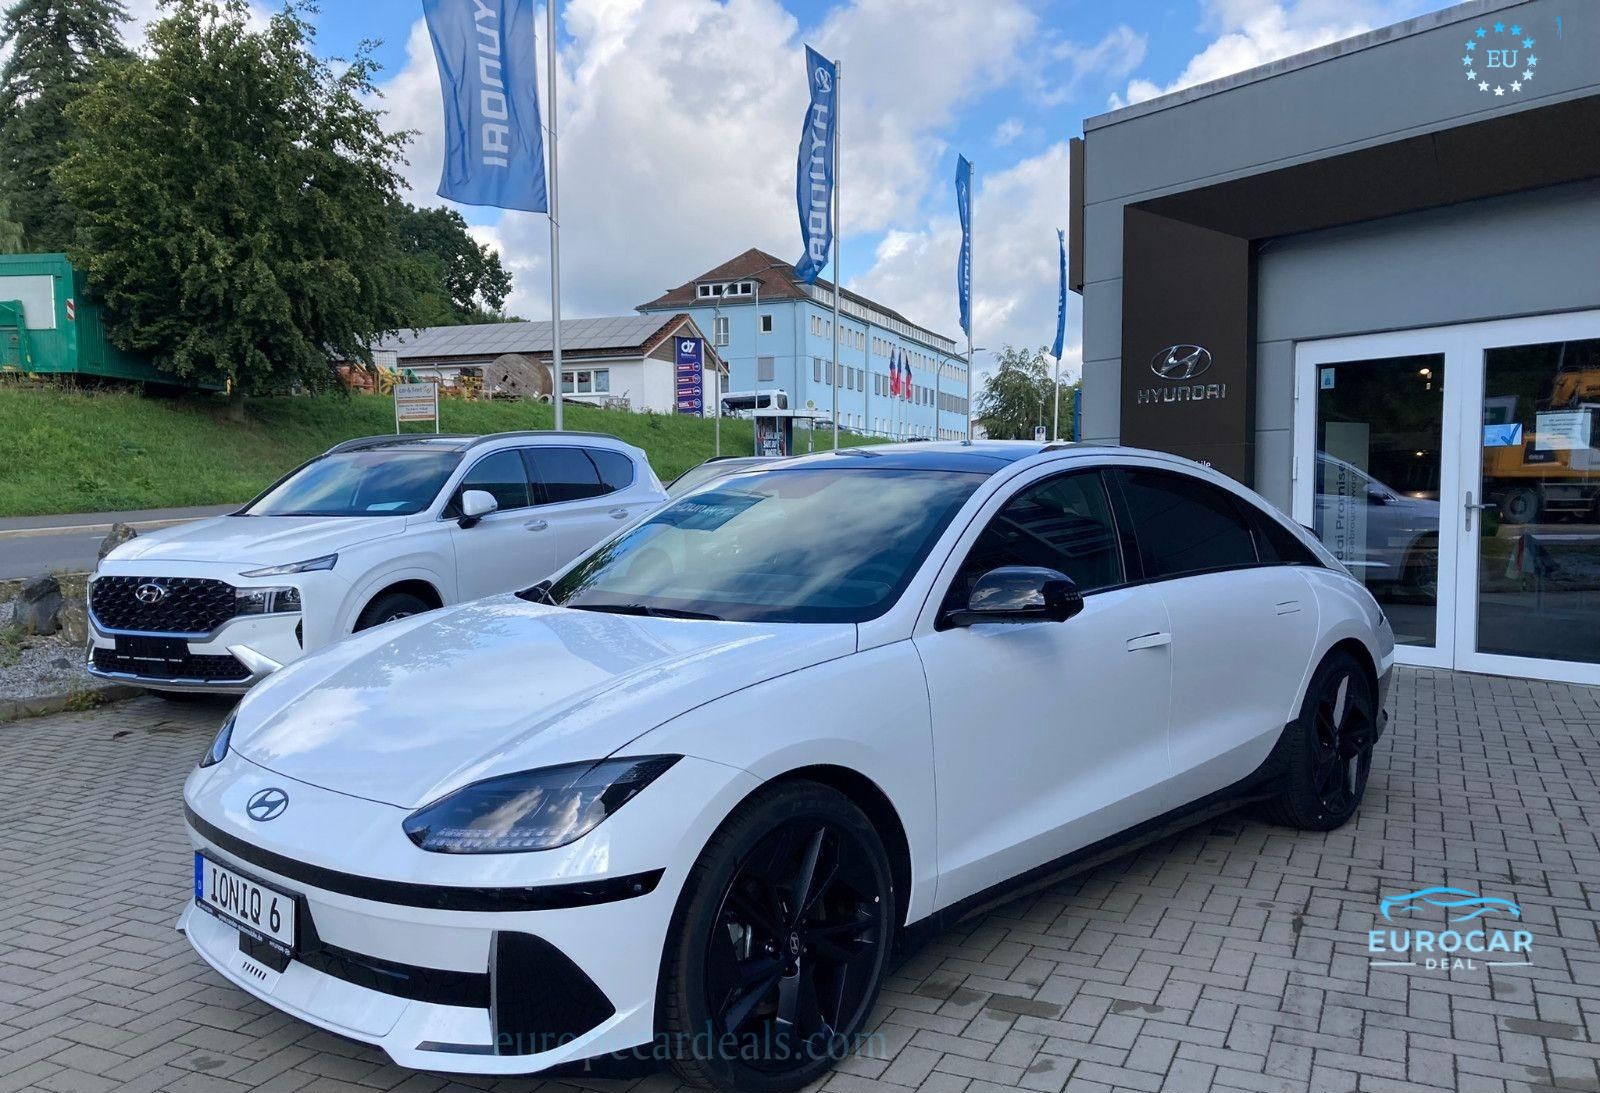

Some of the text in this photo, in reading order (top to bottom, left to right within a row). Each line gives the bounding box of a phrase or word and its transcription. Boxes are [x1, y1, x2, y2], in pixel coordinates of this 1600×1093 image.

[1137, 384, 1226, 404] HYUNDAI
[211, 868, 262, 925] IONIQ
[269, 897, 281, 933] 6
